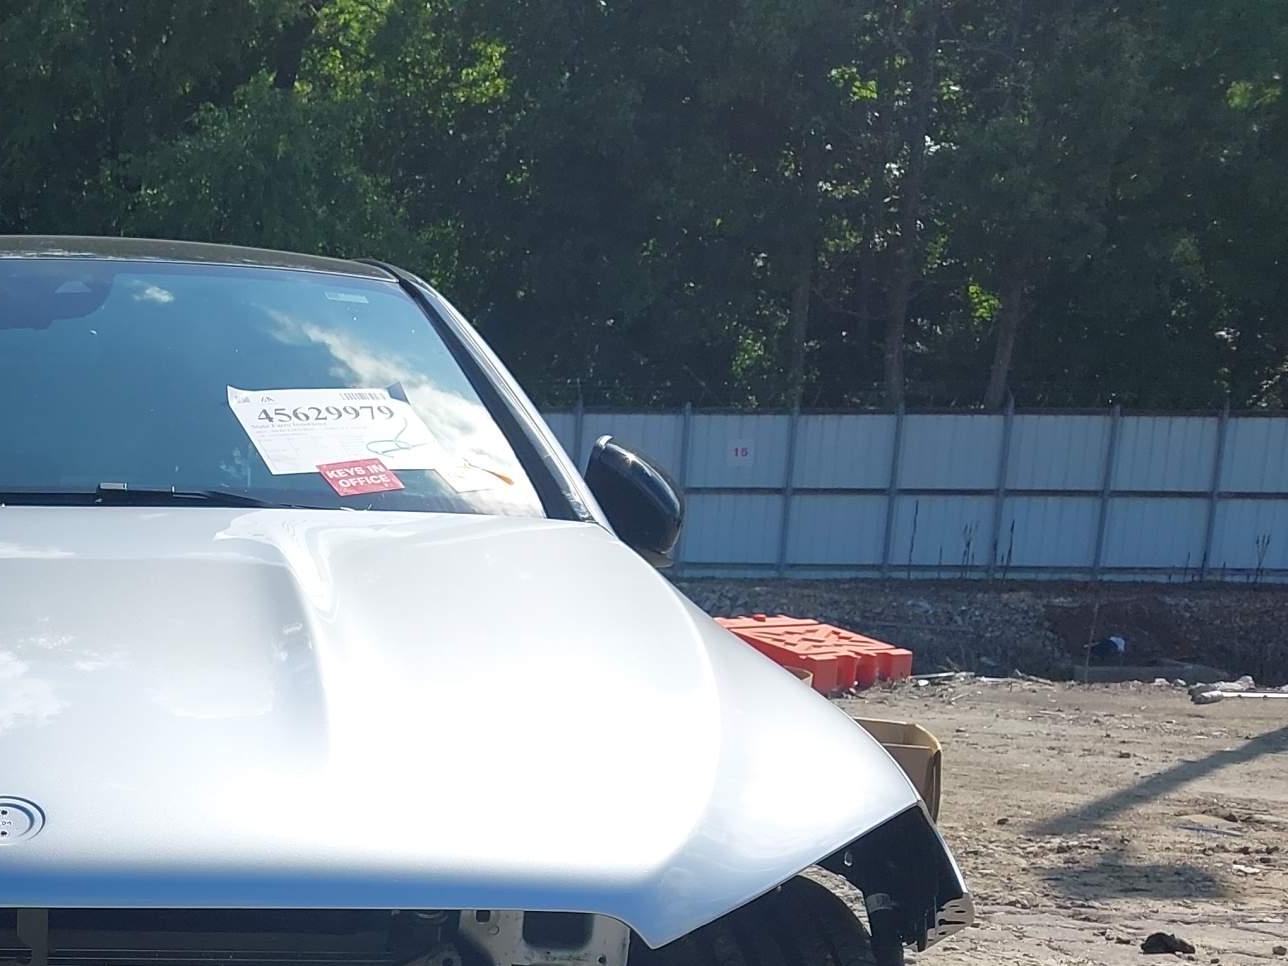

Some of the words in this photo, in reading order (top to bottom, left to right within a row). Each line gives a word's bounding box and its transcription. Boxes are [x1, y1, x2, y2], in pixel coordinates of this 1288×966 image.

[257, 405, 395, 423] 45629979
[326, 466, 366, 479] KEYS
[367, 463, 386, 474] IN
[338, 474, 391, 488] OFFICE
